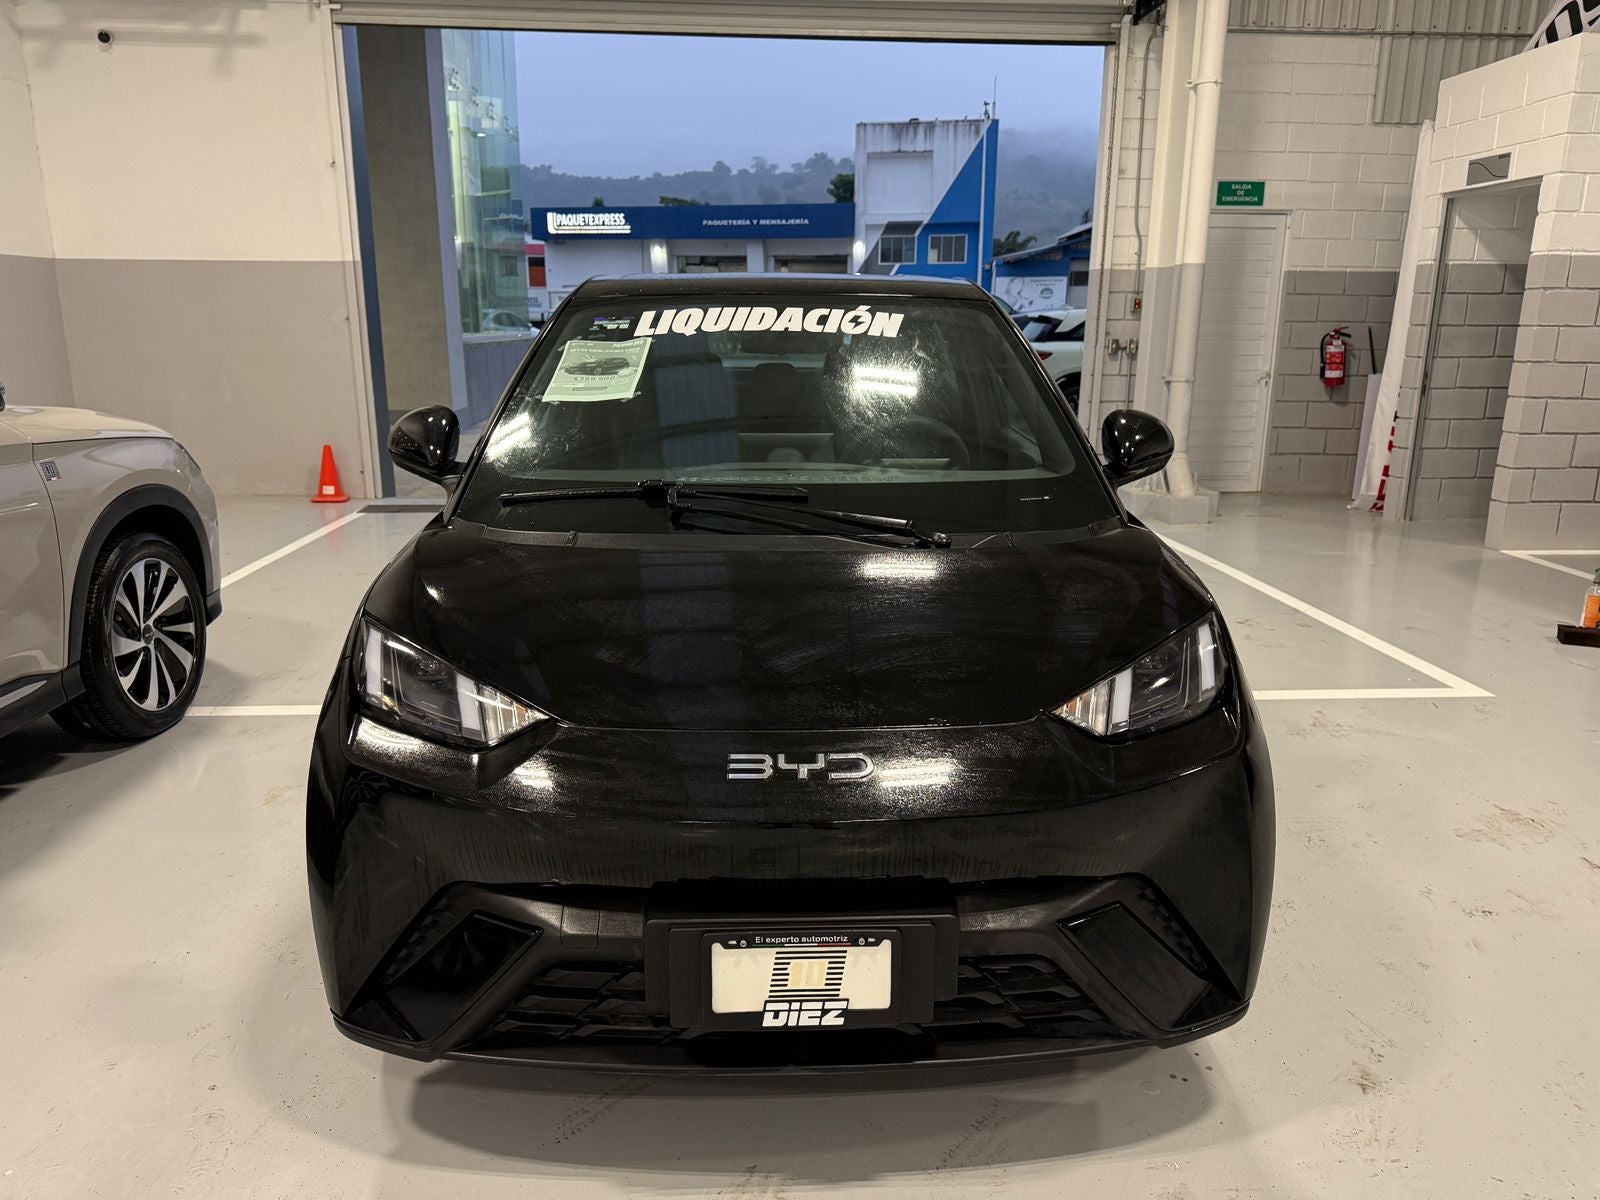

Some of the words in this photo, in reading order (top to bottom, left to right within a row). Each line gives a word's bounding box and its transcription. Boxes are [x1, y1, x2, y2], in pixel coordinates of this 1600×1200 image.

[556, 212, 626, 226] PAQUETEXPRESS
[702, 218, 751, 226] PAQUETERÍA
[759, 217, 809, 225] MENSAJERÍA
[633, 305, 905, 338] LIQUIDACIÓN
[727, 752, 876, 781] BYD
[765, 936, 799, 944] experto
[801, 934, 848, 943] automotriz
[761, 1000, 849, 1027] DIEZ
